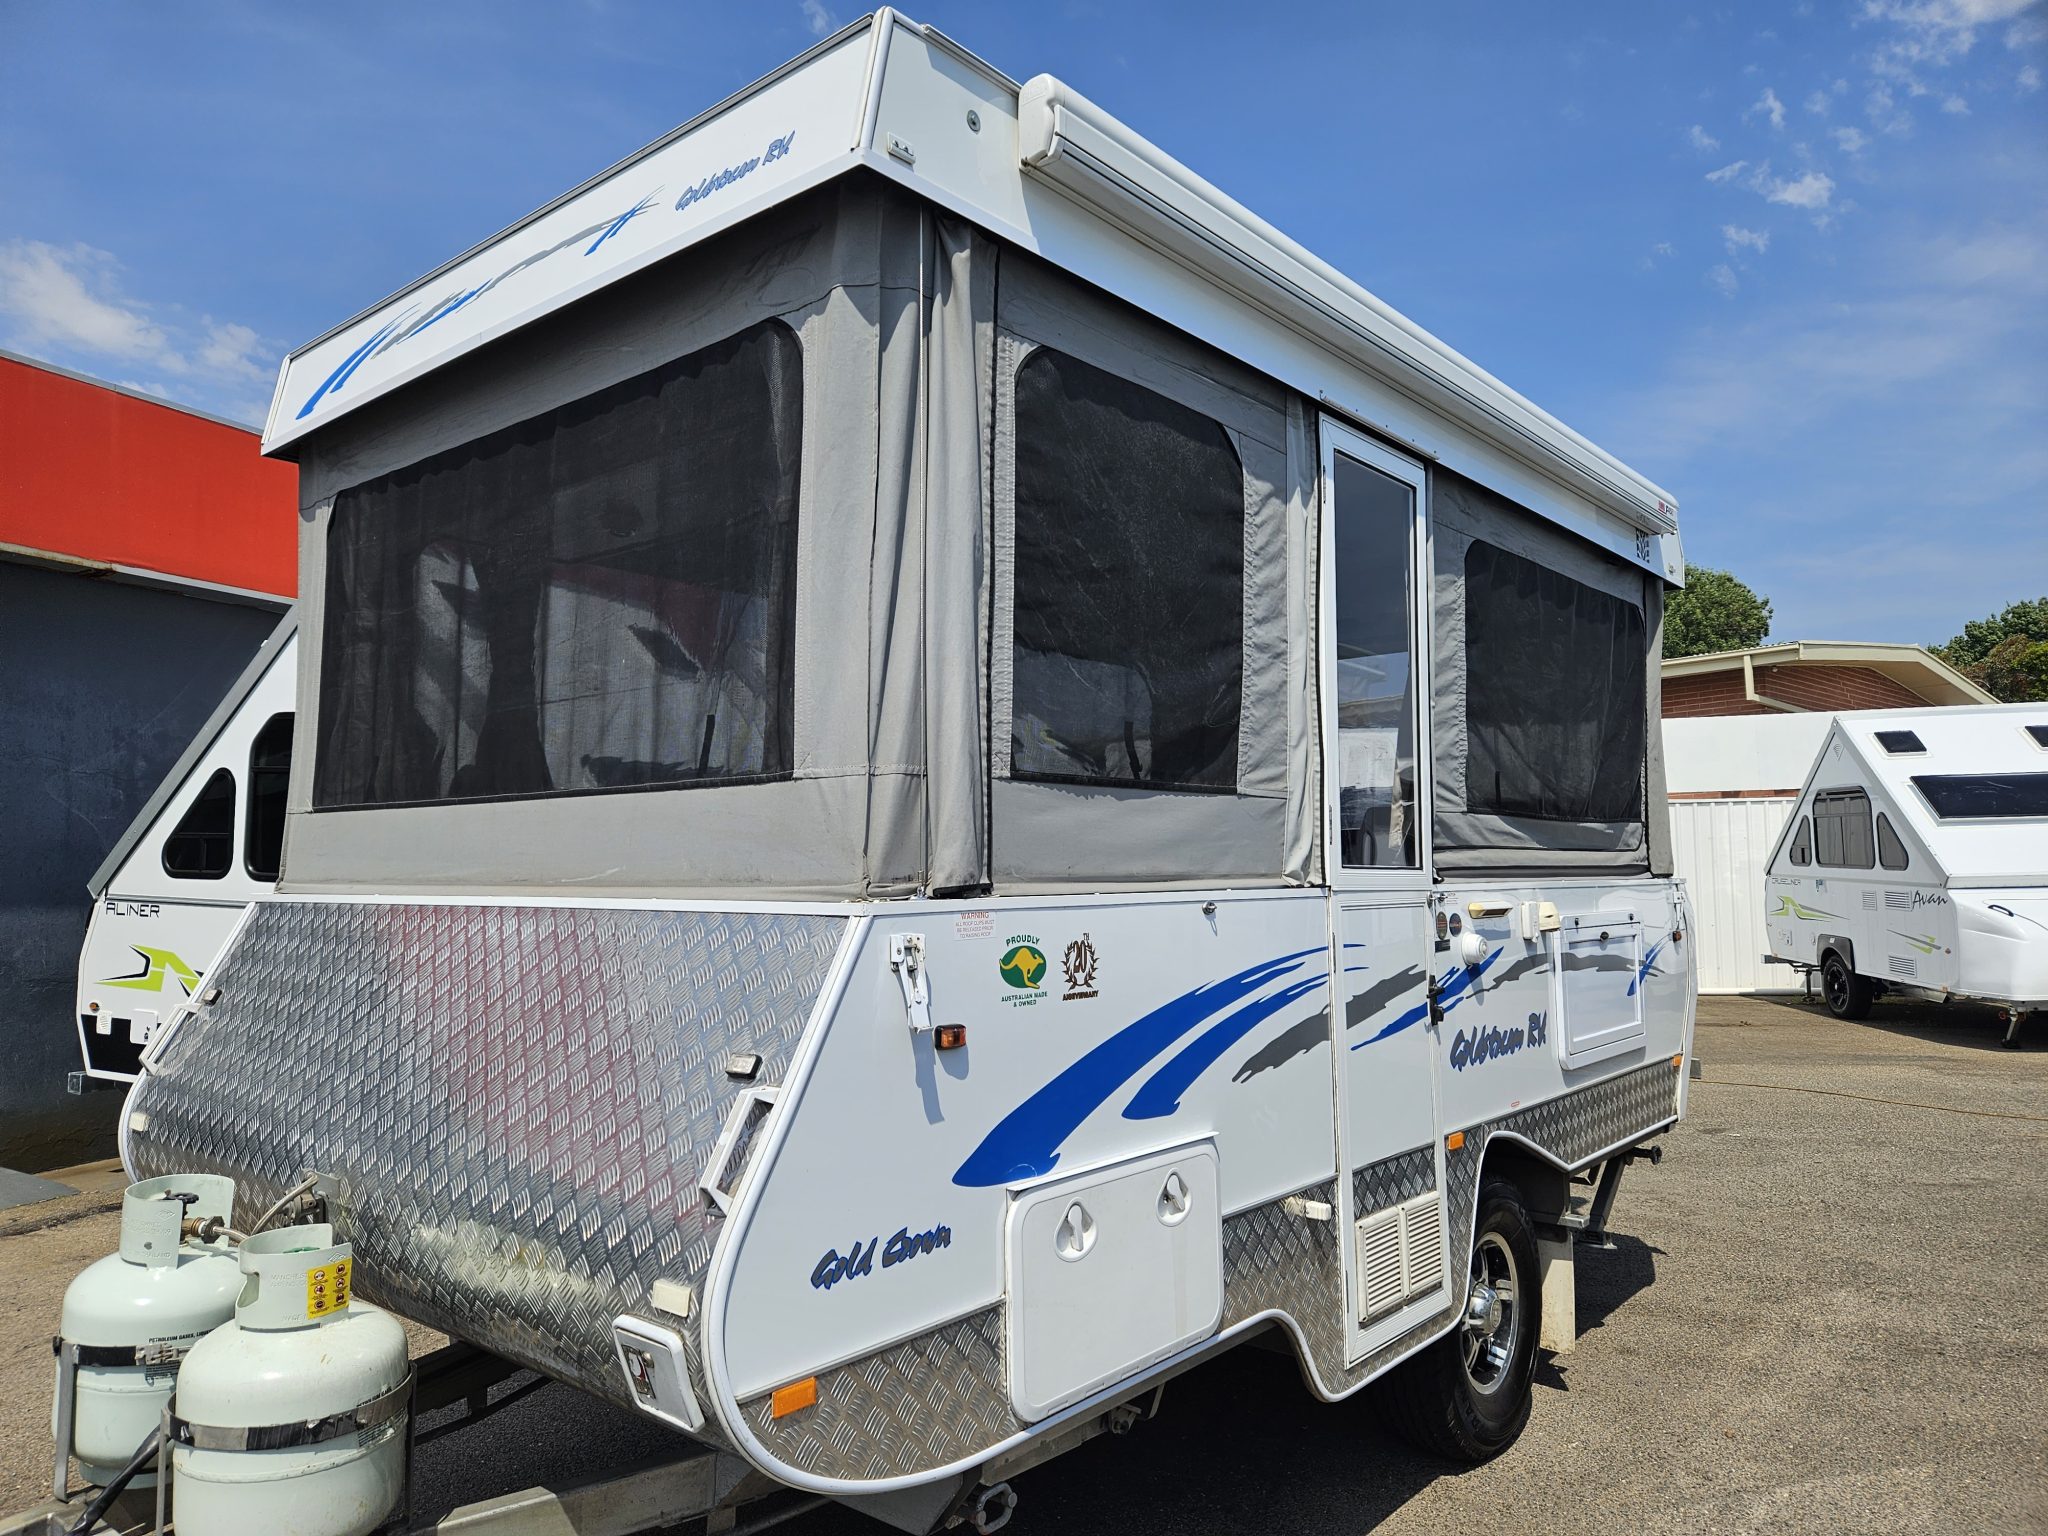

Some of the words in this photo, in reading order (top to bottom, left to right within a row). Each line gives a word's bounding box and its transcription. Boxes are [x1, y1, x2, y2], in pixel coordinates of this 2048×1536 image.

[762, 130, 795, 166] RV
[1911, 890, 1948, 911] Avan
[105, 902, 160, 918] ALINER
[960, 911, 990, 920] WARNING
[1006, 934, 1040, 946] PROUDLY
[1073, 940, 1087, 973] 20
[1001, 993, 1033, 1002] AUSTRALIAN
[1034, 991, 1048, 999] MADE
[1018, 999, 1037, 1007] OWNED
[1527, 1009, 1547, 1048] RV
[811, 1236, 878, 1290] Gold
[882, 1222, 952, 1269] Crown
[148, 1335, 178, 1343] PETROLEUM
